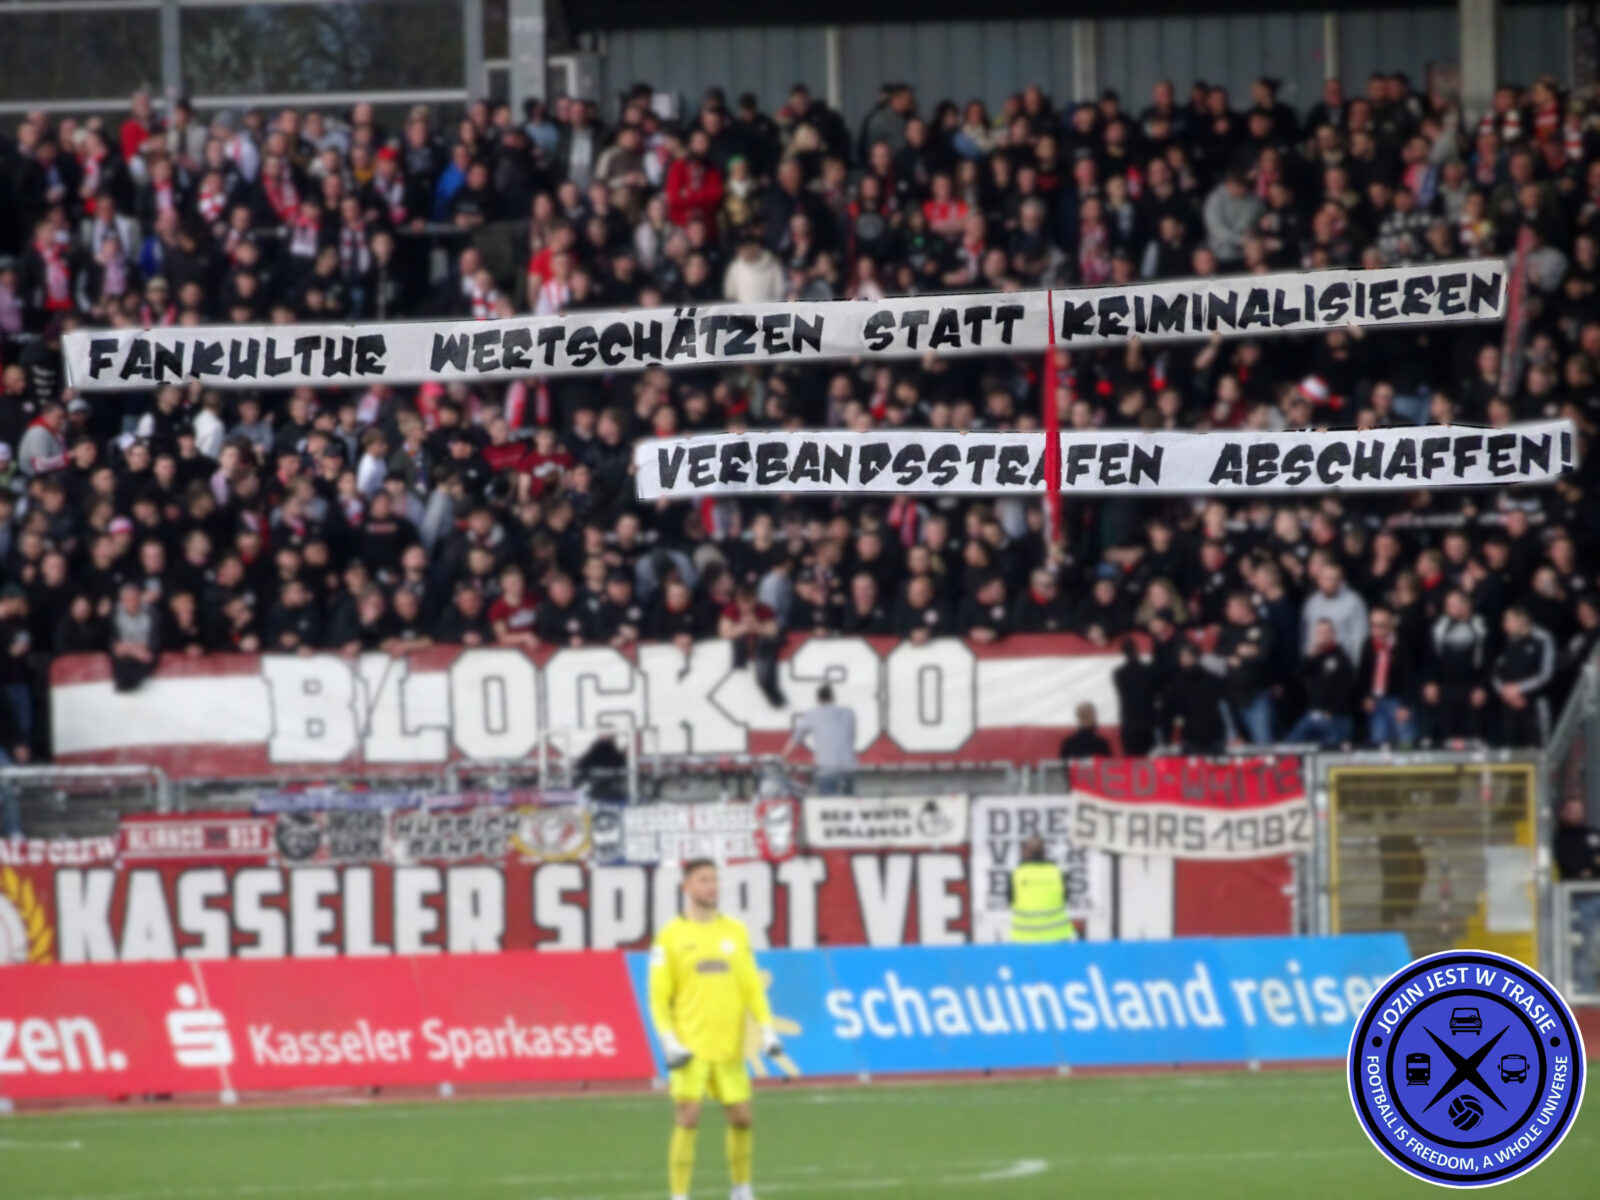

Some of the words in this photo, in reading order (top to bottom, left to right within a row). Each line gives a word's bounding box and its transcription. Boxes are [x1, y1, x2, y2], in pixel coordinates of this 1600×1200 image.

[89, 334, 387, 380] FANKULTUR
[430, 307, 824, 373] WERTSCHÄTZEN
[863, 304, 1025, 351] STATT
[1061, 272, 1503, 341] KRIMINALISIEREN
[1208, 432, 1573, 486] ABSCHAFFEN!
[261, 638, 750, 764] BLOCK
[791, 636, 977, 752] 30
[986, 807, 1070, 836] DRE
[56, 866, 505, 964] KASSELER
[825, 961, 1226, 1040] schauinsland
[1230, 957, 1390, 1027] reise
[249, 1020, 412, 1066] Kasseler
[422, 1014, 617, 1069] Sparkasse
